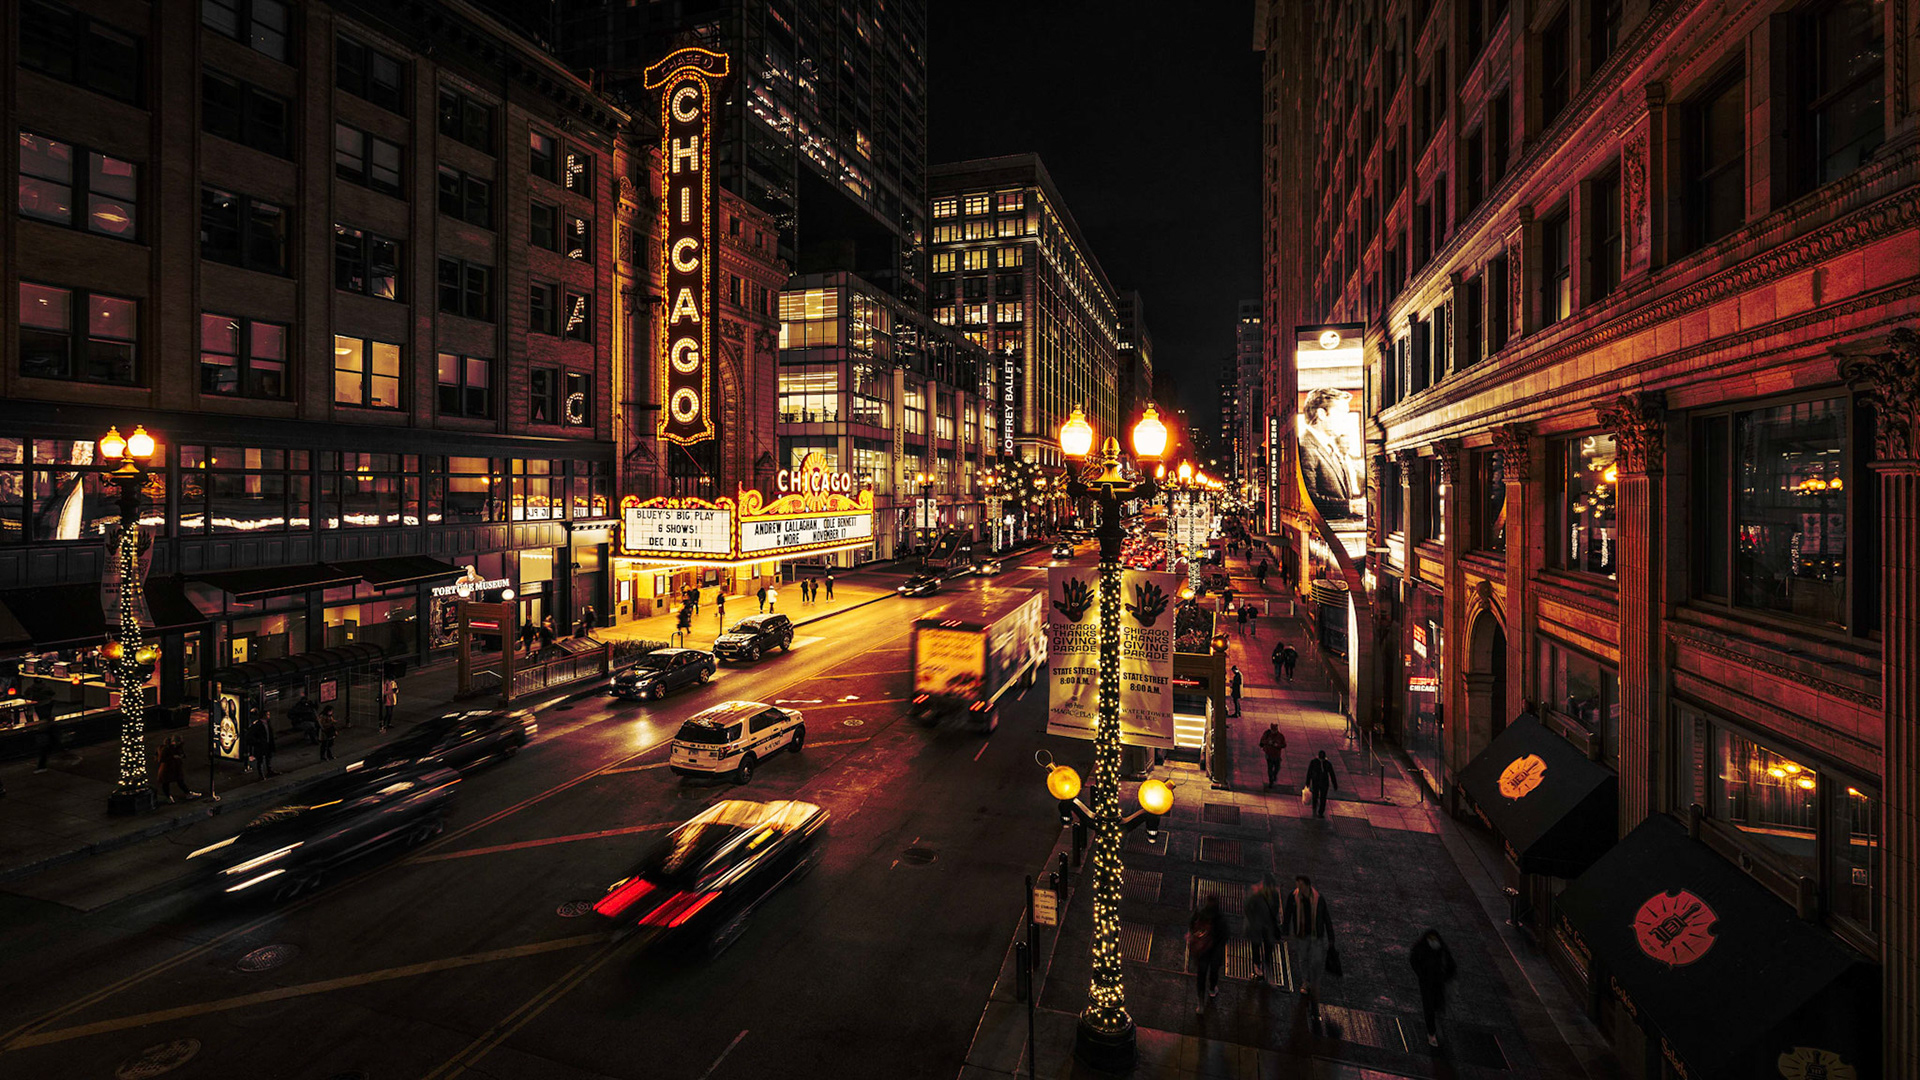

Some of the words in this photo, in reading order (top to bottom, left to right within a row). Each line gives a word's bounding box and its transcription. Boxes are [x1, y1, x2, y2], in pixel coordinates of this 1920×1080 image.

[671, 86, 700, 423] CHICAGO
[1004, 359, 1014, 402] BALLET
[1004, 404, 1014, 456] JOFFREY
[778, 469, 850, 492] CHICAGO
[636, 510, 671, 520] BLUEY'S
[677, 511, 690, 520] BIG
[695, 512, 714, 520] PLAY
[658, 524, 662, 533] 6
[666, 524, 698, 534] SHOWS!
[754, 522, 782, 535] ANDREW
[823, 518, 835, 529] COLE
[838, 516, 856, 527] BENNETT
[783, 533, 800, 545] MORE
[812, 529, 838, 542] NOVEMBER
[841, 528, 847, 538] 17
[649, 537, 664, 546] DEC
[668, 538, 677, 546] 10
[682, 539, 688, 547] &
[695, 539, 701, 548] 11
[475, 578, 510, 591] MUSEUM
[1124, 627, 1169, 637] CHICAGO
[1053, 637, 1096, 645] GIVING
[1124, 634, 1169, 644] THANKS
[1124, 640, 1168, 652] GIVING
[1124, 649, 1168, 660] PARADE
[1073, 667, 1097, 675] STREET
[1123, 672, 1142, 681] STATE
[1144, 675, 1168, 685] STREET
[1130, 683, 1145, 692] 8:00
[1146, 710, 1171, 718] TOWER
